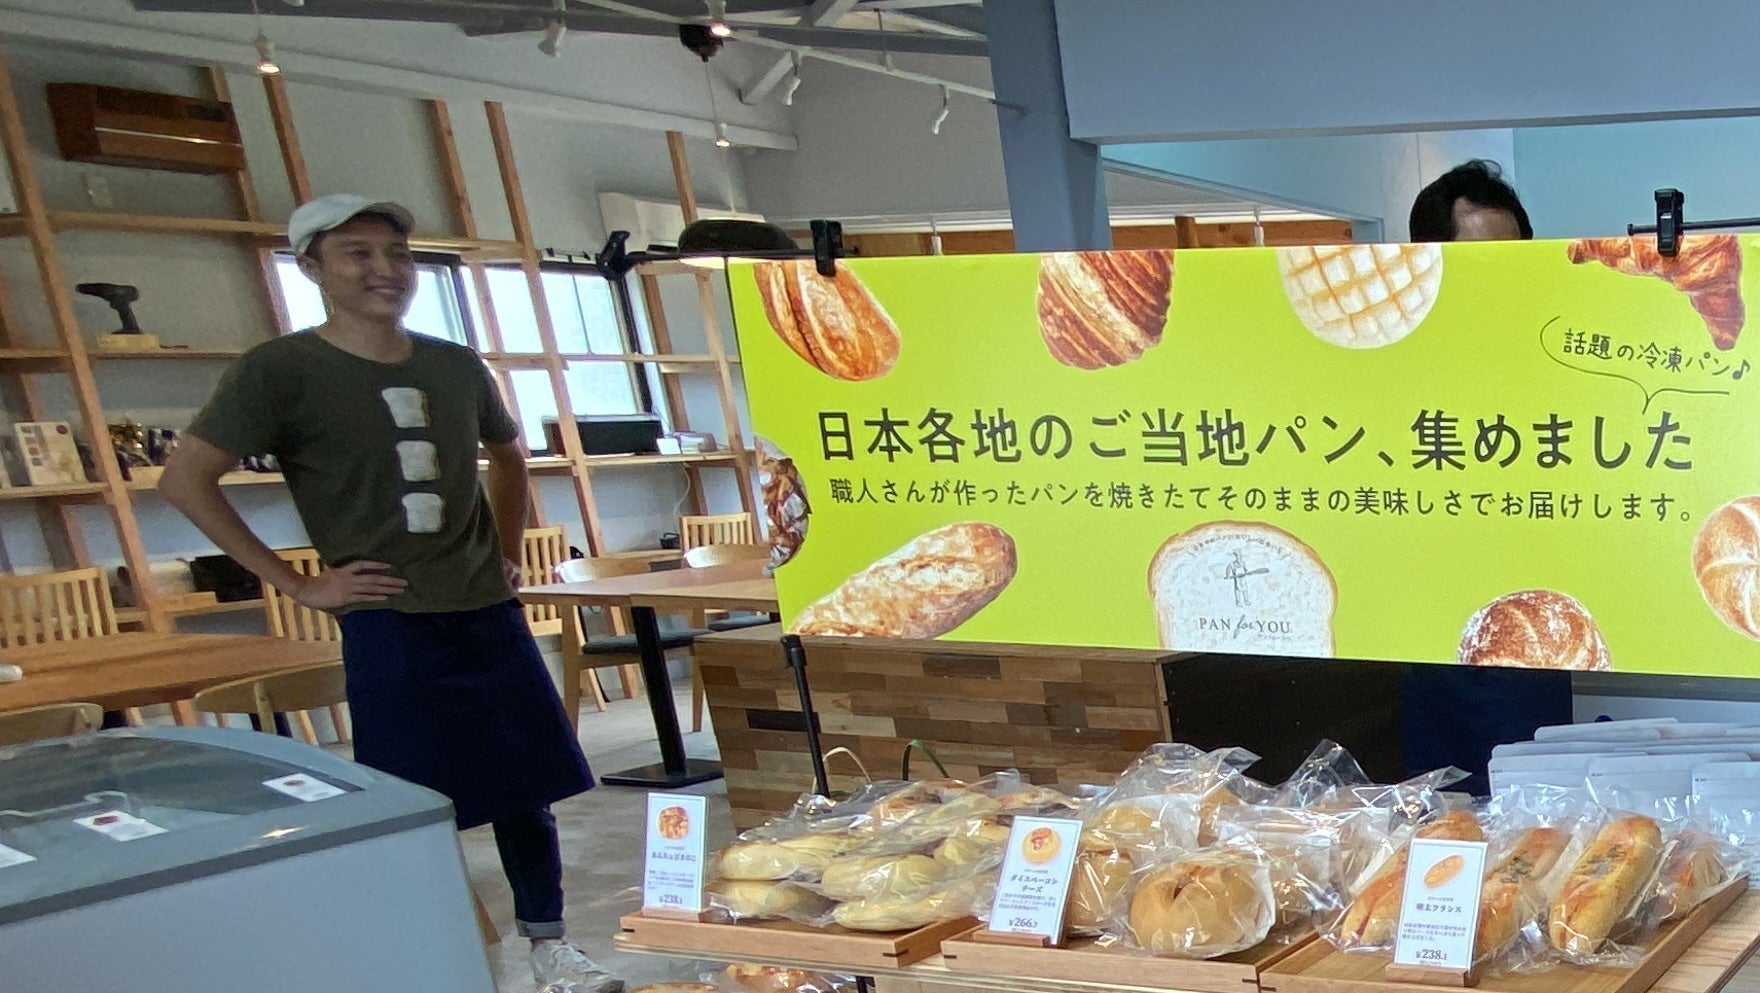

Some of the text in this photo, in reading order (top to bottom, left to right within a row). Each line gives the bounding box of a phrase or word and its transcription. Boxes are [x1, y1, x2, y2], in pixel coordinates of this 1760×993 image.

[818, 407, 1693, 471] 日本各地のご当地パン、集めました
[829, 477, 1690, 522] 職人さんが作ったパンを焼きたてそのままの美味しさでお届けします。
[1199, 617, 1232, 631] PAN
[1256, 620, 1292, 634] YOU
